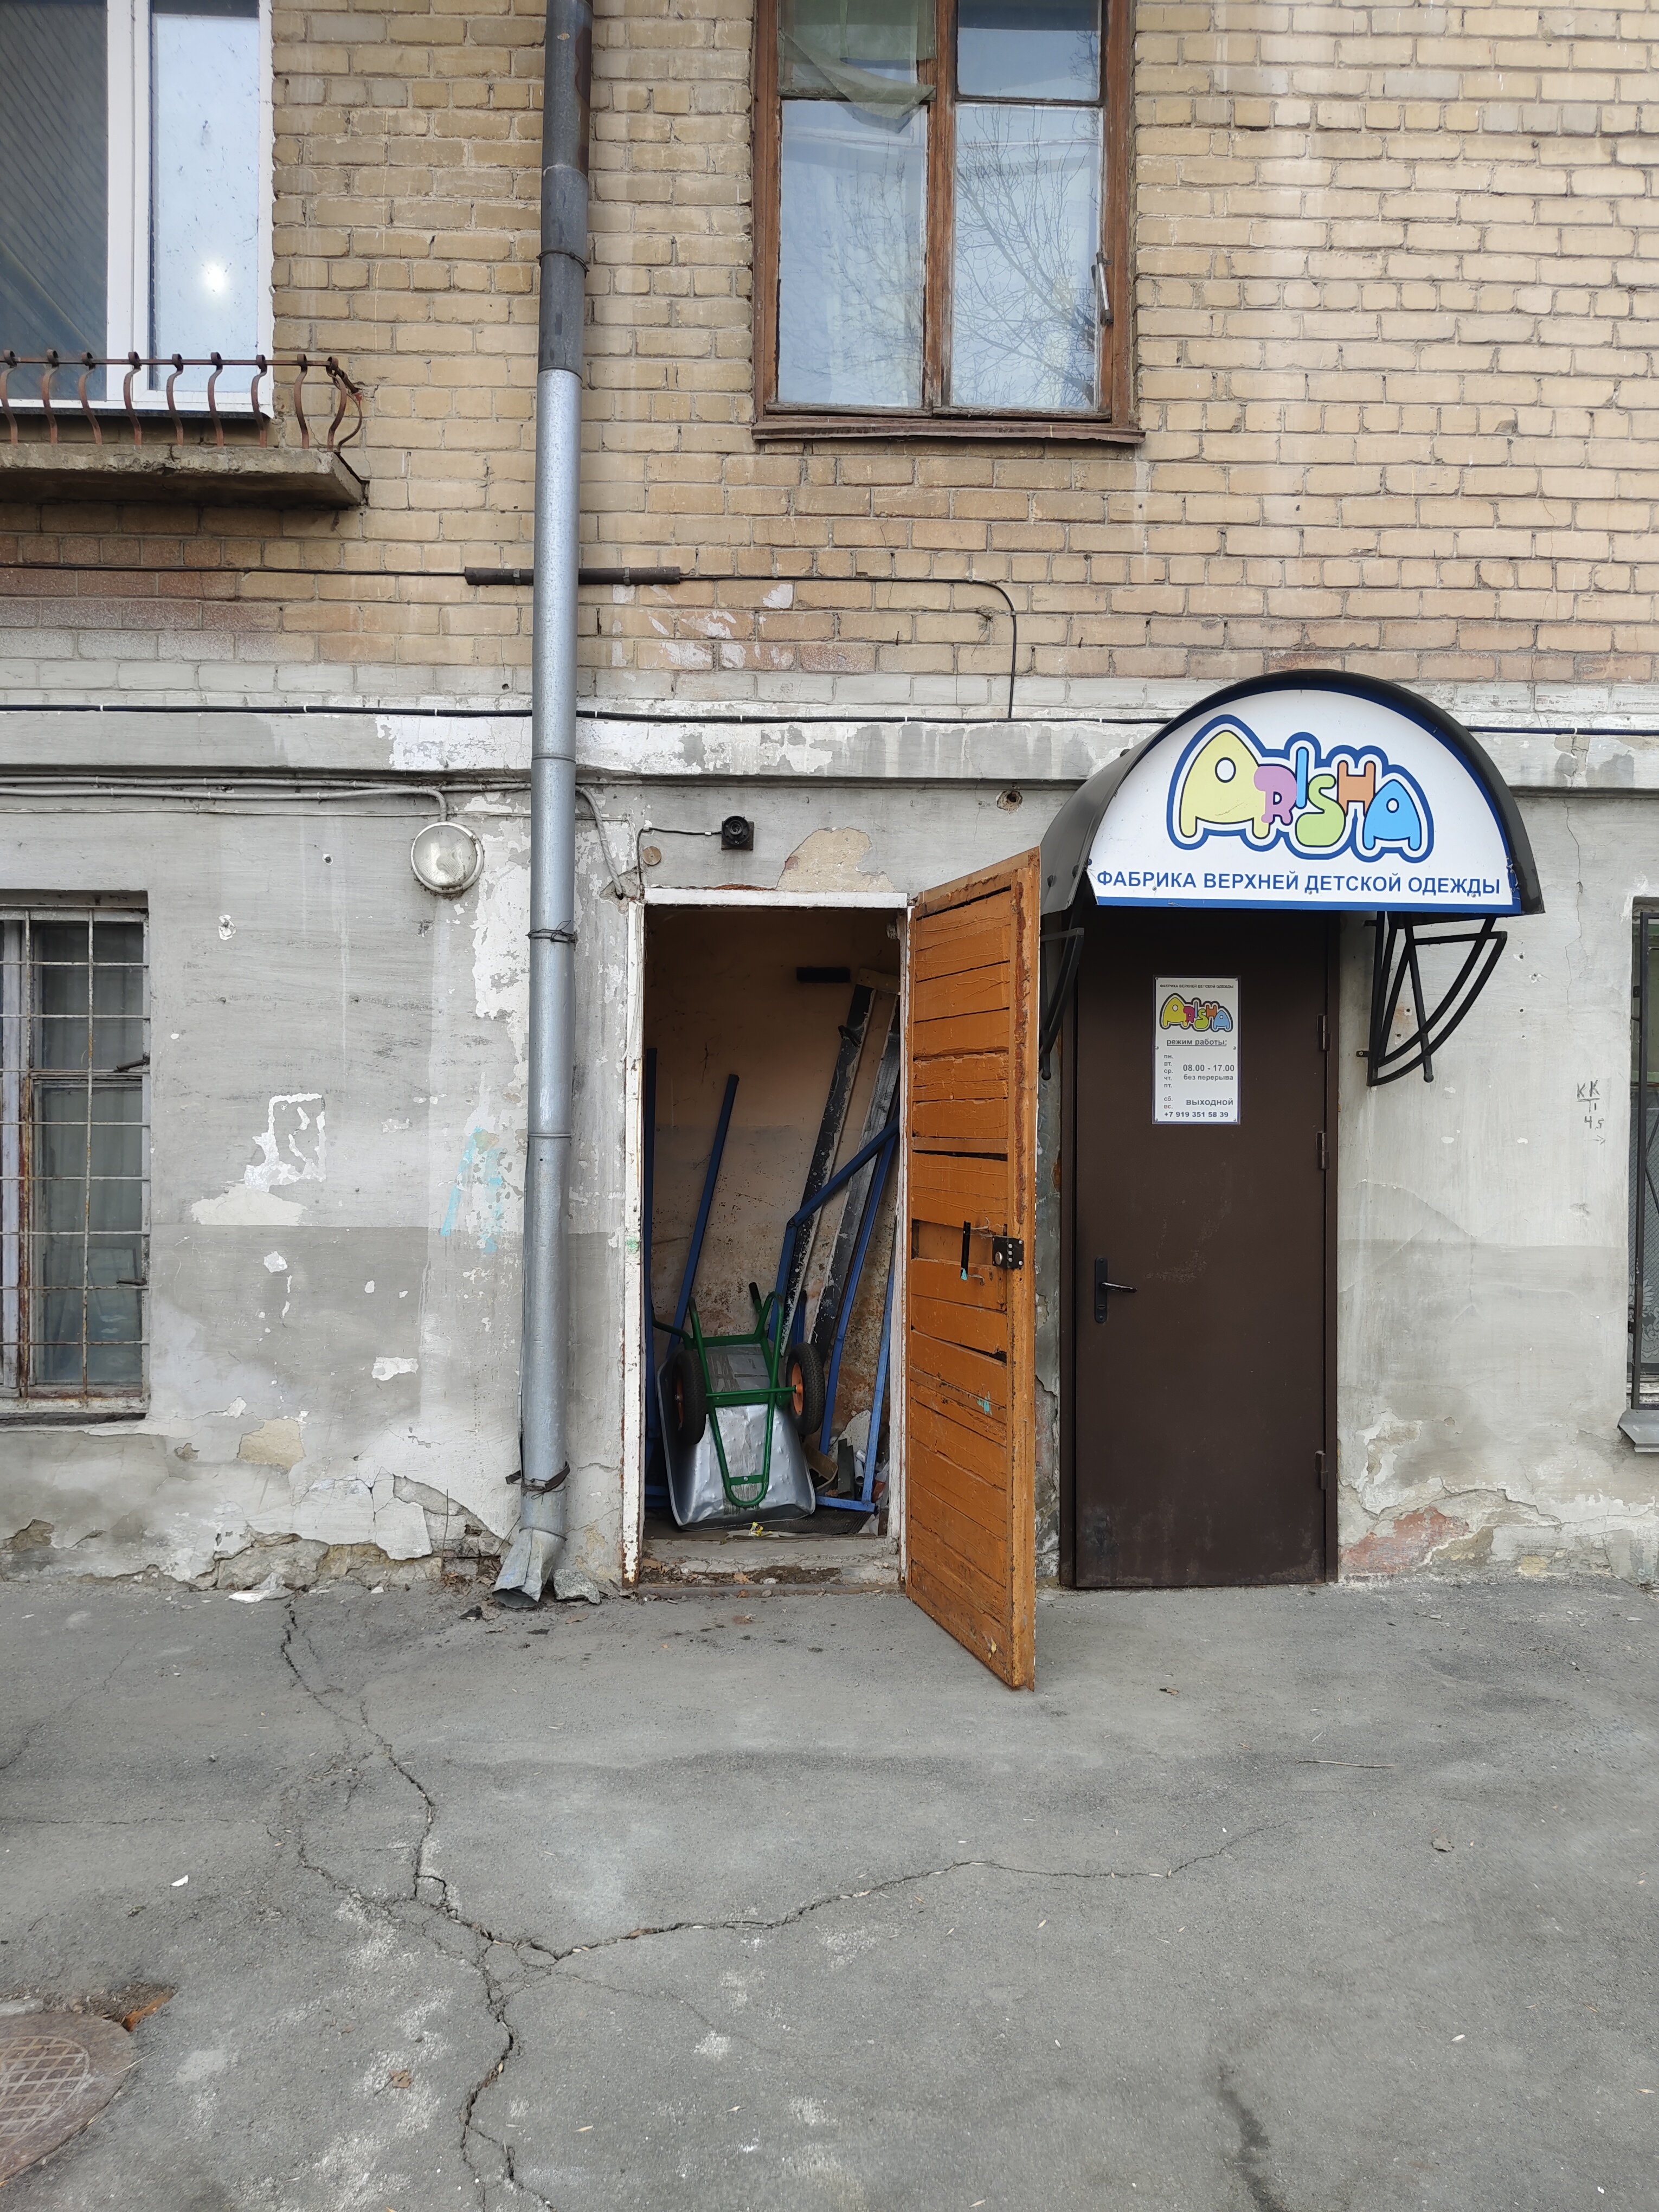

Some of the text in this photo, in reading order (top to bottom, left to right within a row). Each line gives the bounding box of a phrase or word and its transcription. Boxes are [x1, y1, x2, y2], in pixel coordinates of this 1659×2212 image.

[1097, 870, 1500, 897] ФАБРИКА ВЕРХНЕЙ ДЕТСКОЙ ОДЕЖДЫ
[1195, 1038, 1227, 1046] работы:
